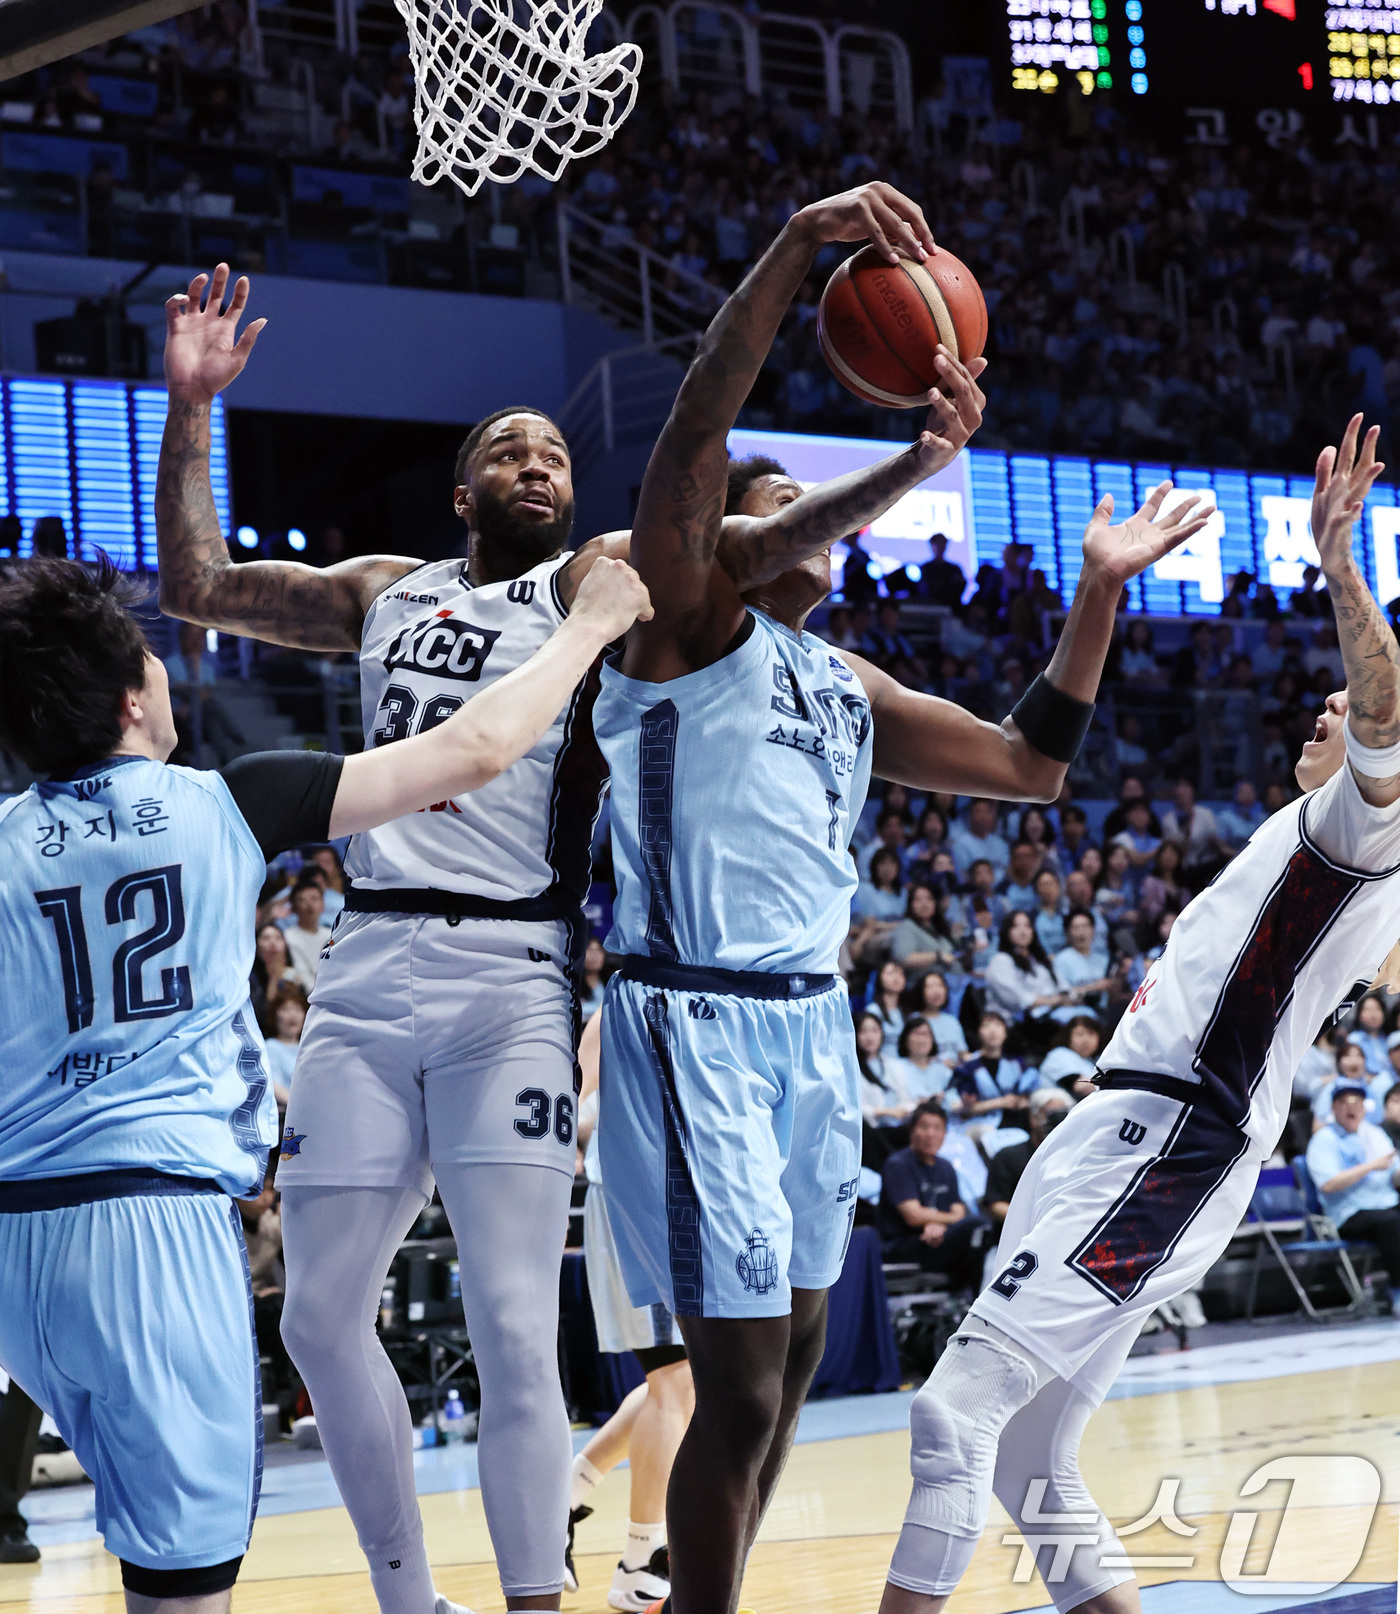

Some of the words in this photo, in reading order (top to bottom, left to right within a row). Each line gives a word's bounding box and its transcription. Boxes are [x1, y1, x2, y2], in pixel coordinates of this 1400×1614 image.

[872, 273, 921, 343] molten
[388, 610, 486, 674] KCC
[36, 798, 169, 857] 강지훈
[33, 863, 193, 1034] 12
[513, 1087, 575, 1147] 36
[988, 1249, 1039, 1302] 2
